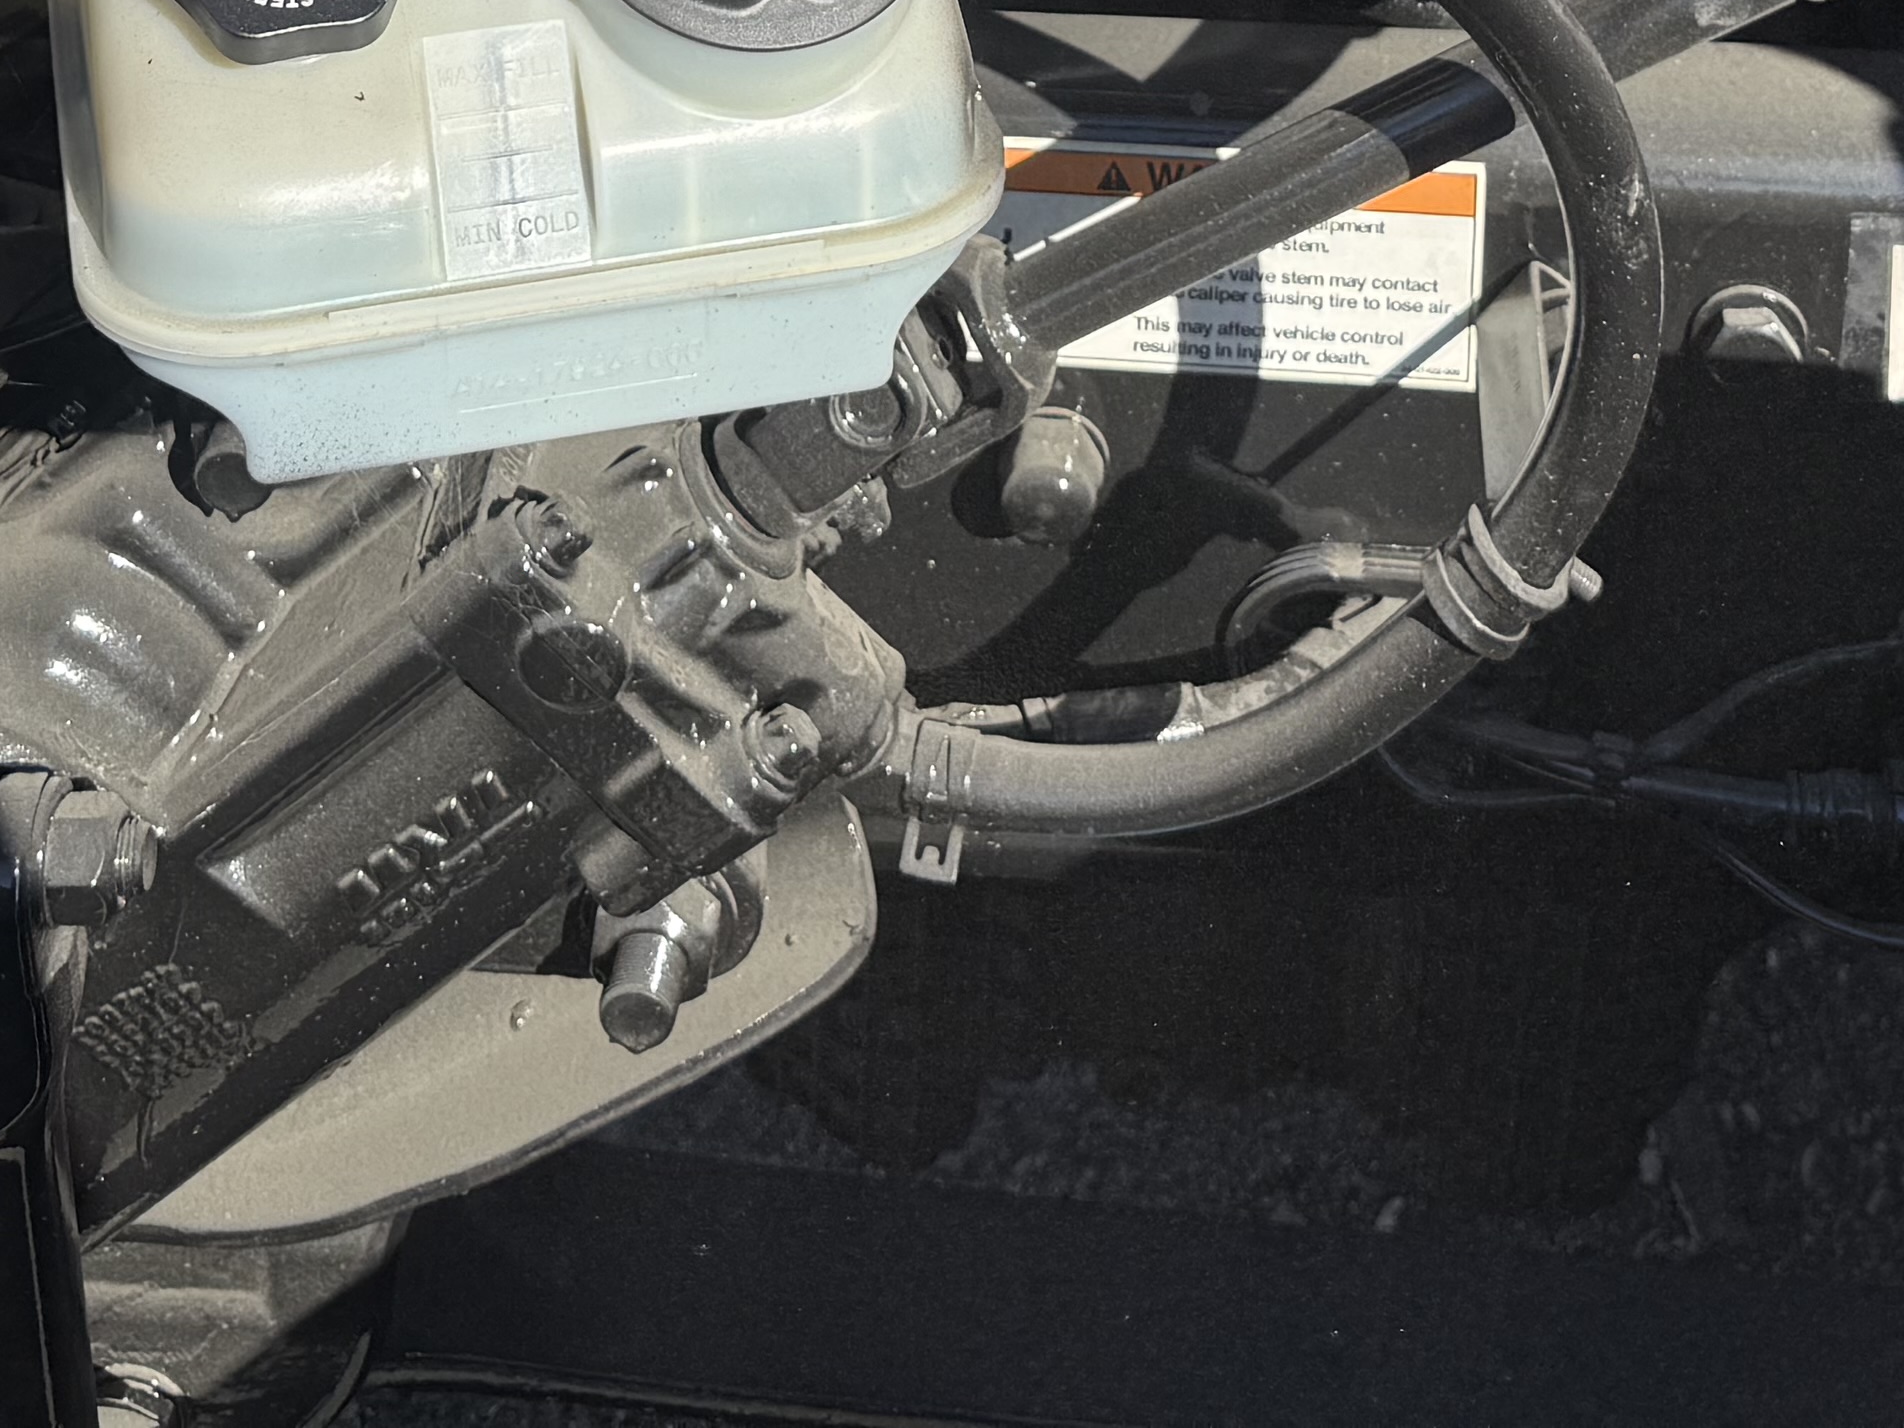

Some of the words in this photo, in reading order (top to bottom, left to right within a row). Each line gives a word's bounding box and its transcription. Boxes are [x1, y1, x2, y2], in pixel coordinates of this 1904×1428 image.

[437, 61, 488, 87] MAX
[504, 55, 560, 78] FILL
[455, 220, 502, 247] MIN
[518, 210, 580, 238] COLD
[1307, 217, 1386, 237] uipment
[1229, 268, 1276, 283] valve
[1282, 270, 1325, 286] stem
[1329, 274, 1366, 294] may
[1372, 276, 1438, 294] contact
[1188, 286, 1249, 309] caliper
[1253, 290, 1323, 312] causing
[1329, 296, 1356, 311] tire
[1362, 297, 1381, 312] to
[1386, 296, 1424, 314] lose
[1134, 315, 1170, 333] This
[1177, 321, 1212, 341] may
[1217, 320, 1267, 339] affect
[1272, 326, 1336, 343] vehicle
[1341, 329, 1404, 347] control
[1133, 339, 1210, 362] resulting
[1215, 344, 1232, 358] in
[1237, 345, 1286, 367] injury
[1292, 349, 1311, 363] or
[1316, 348, 1371, 367] death.
